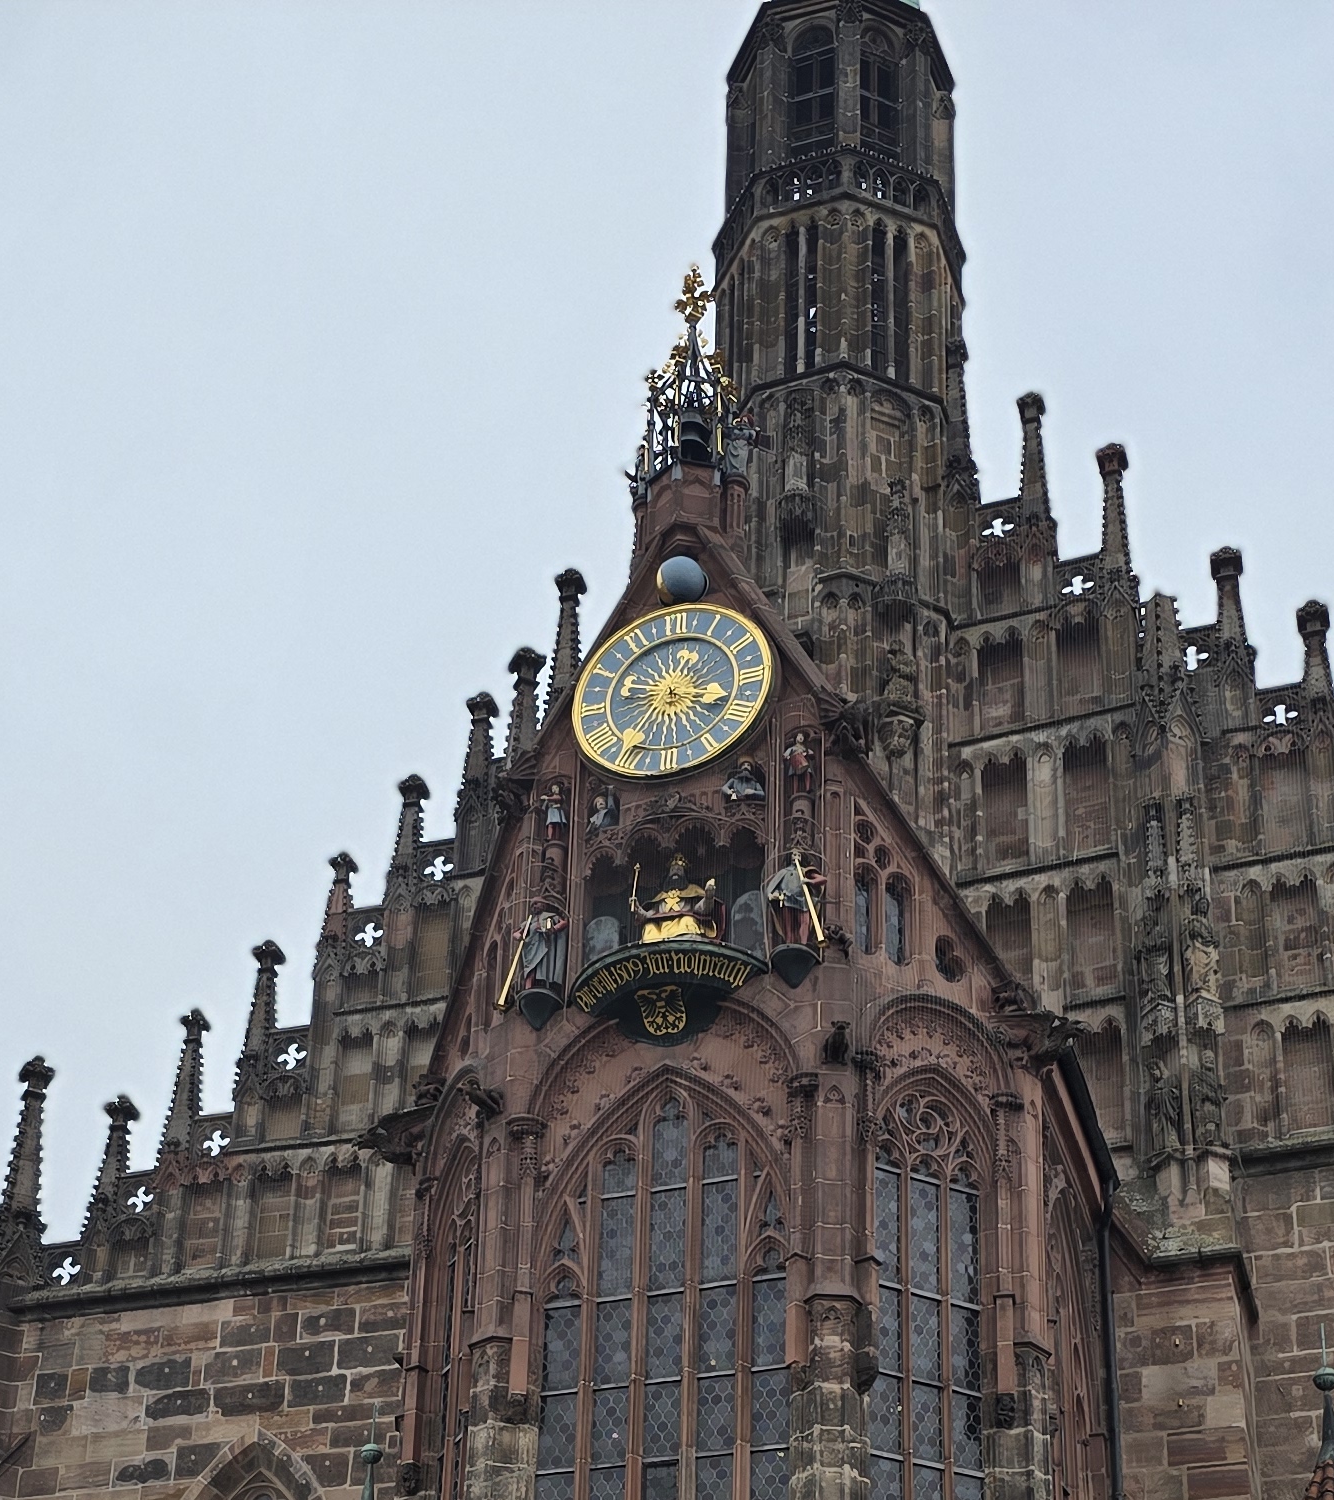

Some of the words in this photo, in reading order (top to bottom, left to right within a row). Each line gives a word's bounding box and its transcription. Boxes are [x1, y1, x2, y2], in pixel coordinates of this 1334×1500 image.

[665, 612, 687, 636] XII
[624, 628, 649, 653] XI
[729, 631, 754, 655] II
[739, 664, 764, 687] III
[610, 958, 643, 986] 1509
